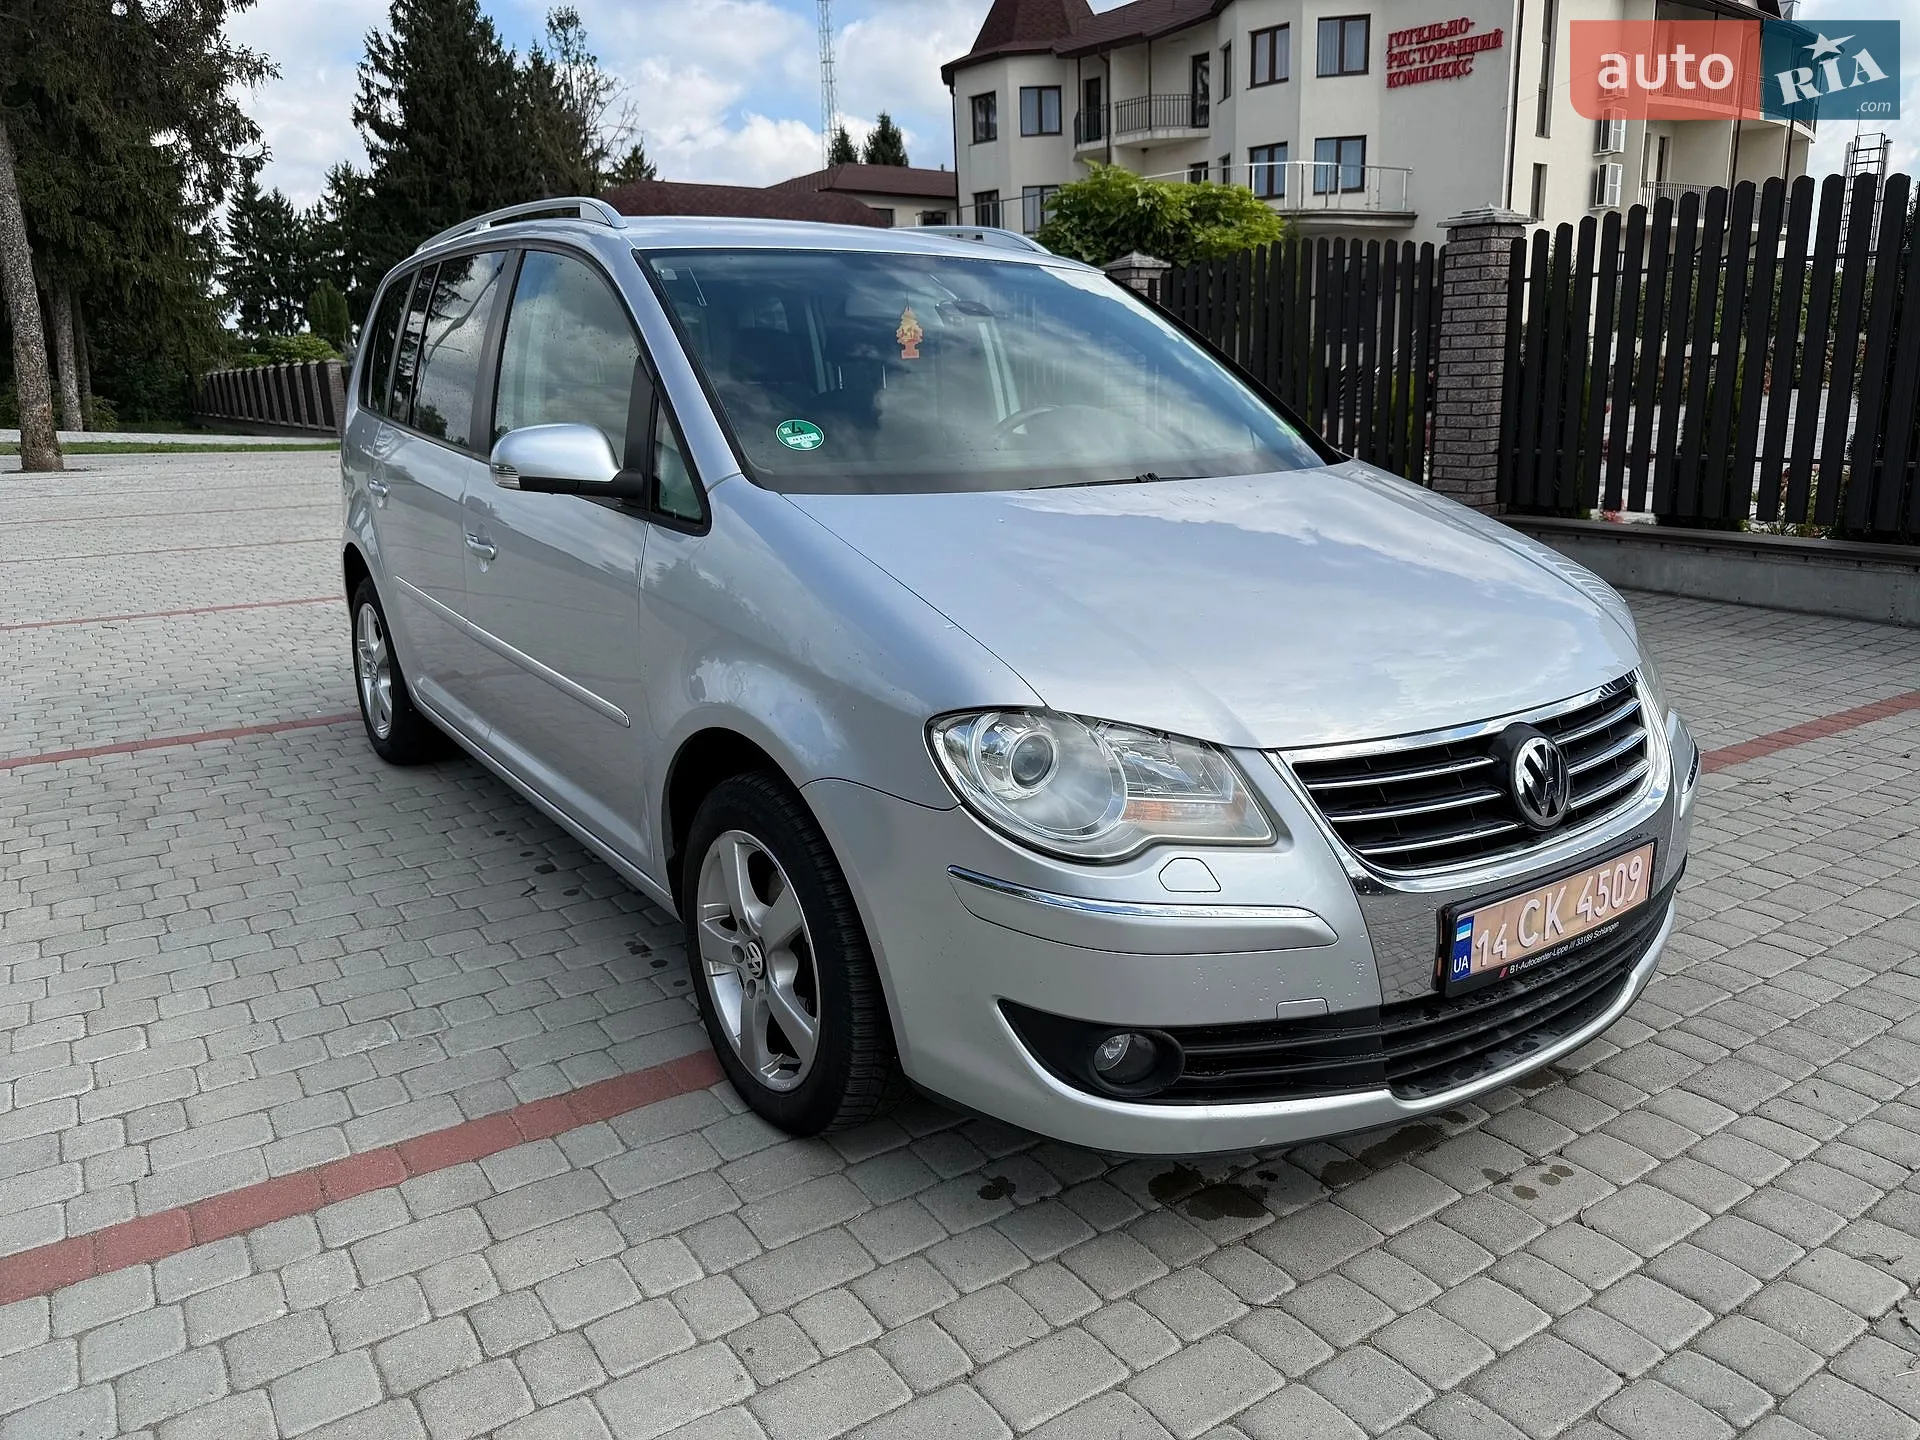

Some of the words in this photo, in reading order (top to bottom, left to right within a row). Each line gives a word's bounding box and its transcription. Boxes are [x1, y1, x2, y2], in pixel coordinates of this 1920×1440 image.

[1387, 17, 1475, 49] ГОТЕЛЬНО-
[1386, 57, 1474, 88] КОМПЛЕКС
[1474, 922, 1508, 967] 14
[1516, 885, 1566, 948] CK
[1575, 855, 1644, 923] 4509
[1453, 955, 1469, 974] UA
